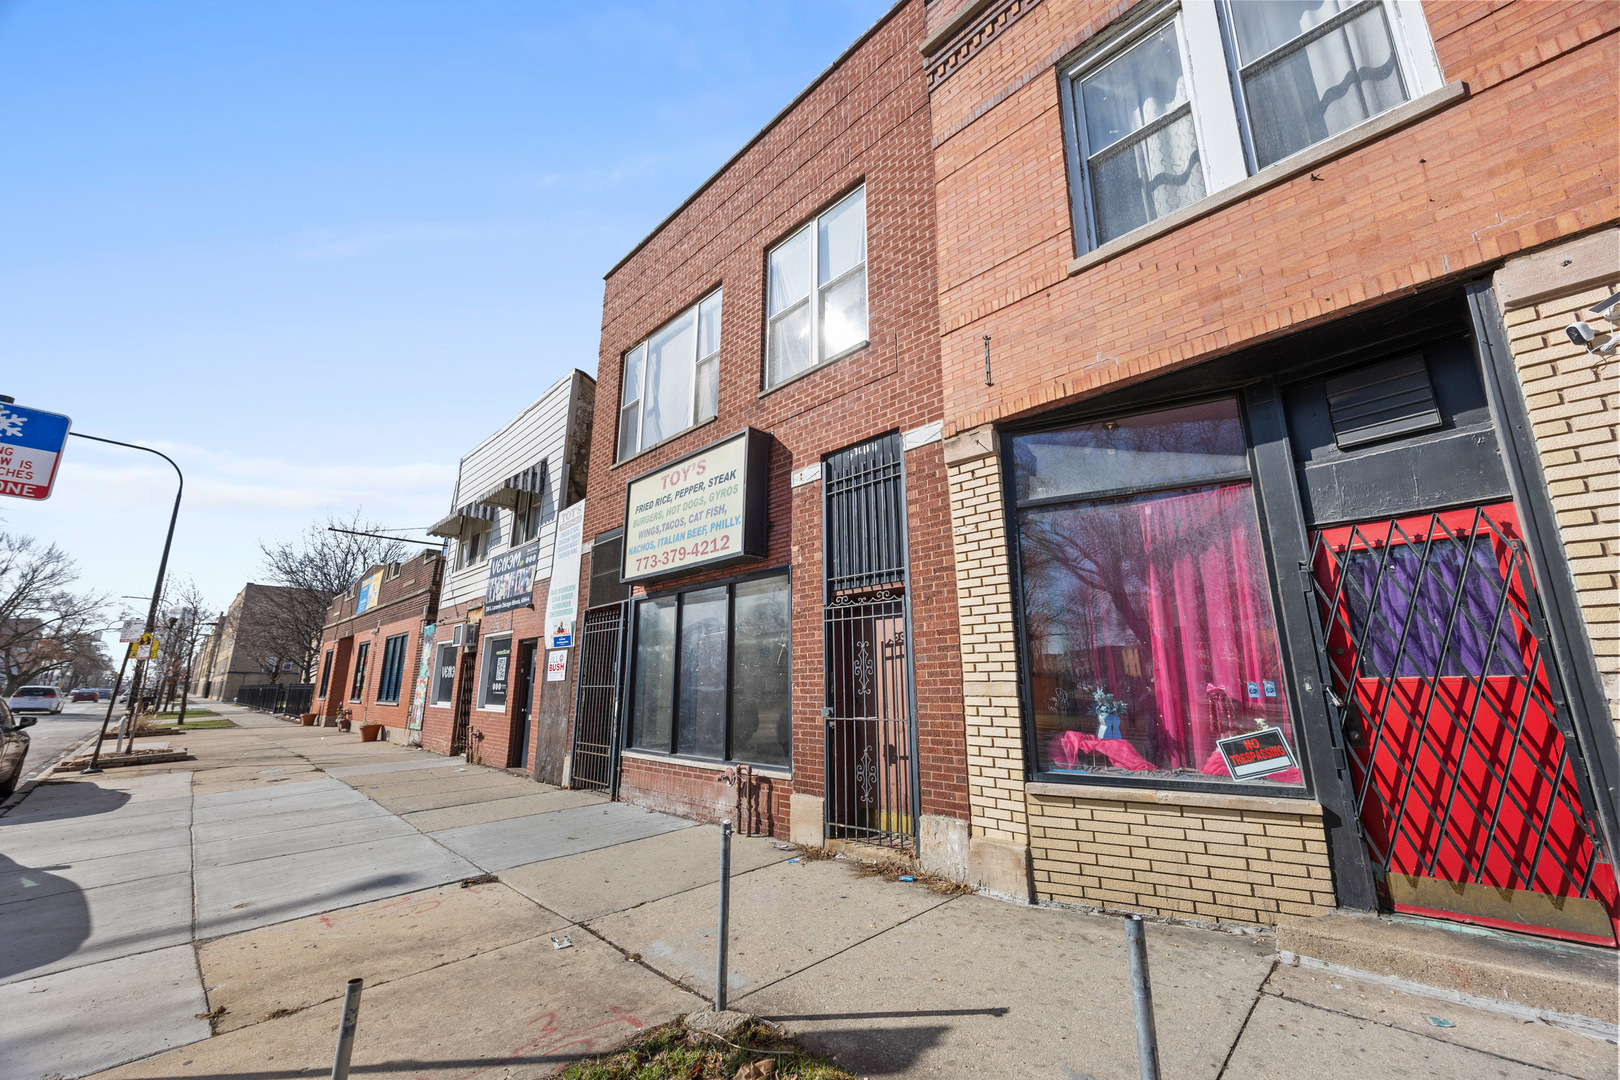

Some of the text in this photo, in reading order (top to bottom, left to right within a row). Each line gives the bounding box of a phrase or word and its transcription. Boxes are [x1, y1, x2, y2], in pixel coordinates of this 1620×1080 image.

[0, 466, 34, 480] CHES
[19, 460, 33, 470] IS
[660, 458, 707, 490] TOY'S
[635, 469, 737, 514] FRIED RICE, PEPPER, STEAK
[632, 484, 739, 528] BURGERS, HOT DOGS, GYROS
[688, 511, 704, 524] CAT
[705, 504, 727, 519] FISH,
[628, 514, 741, 556] NACHOS, ITALIAN BEEF, PHILLY.
[635, 534, 730, 572] 773-379-4212
[549, 662, 565, 672] BUSH
[1229, 744, 1286, 766] TRESPASSING
[1242, 738, 1260, 751] NO
